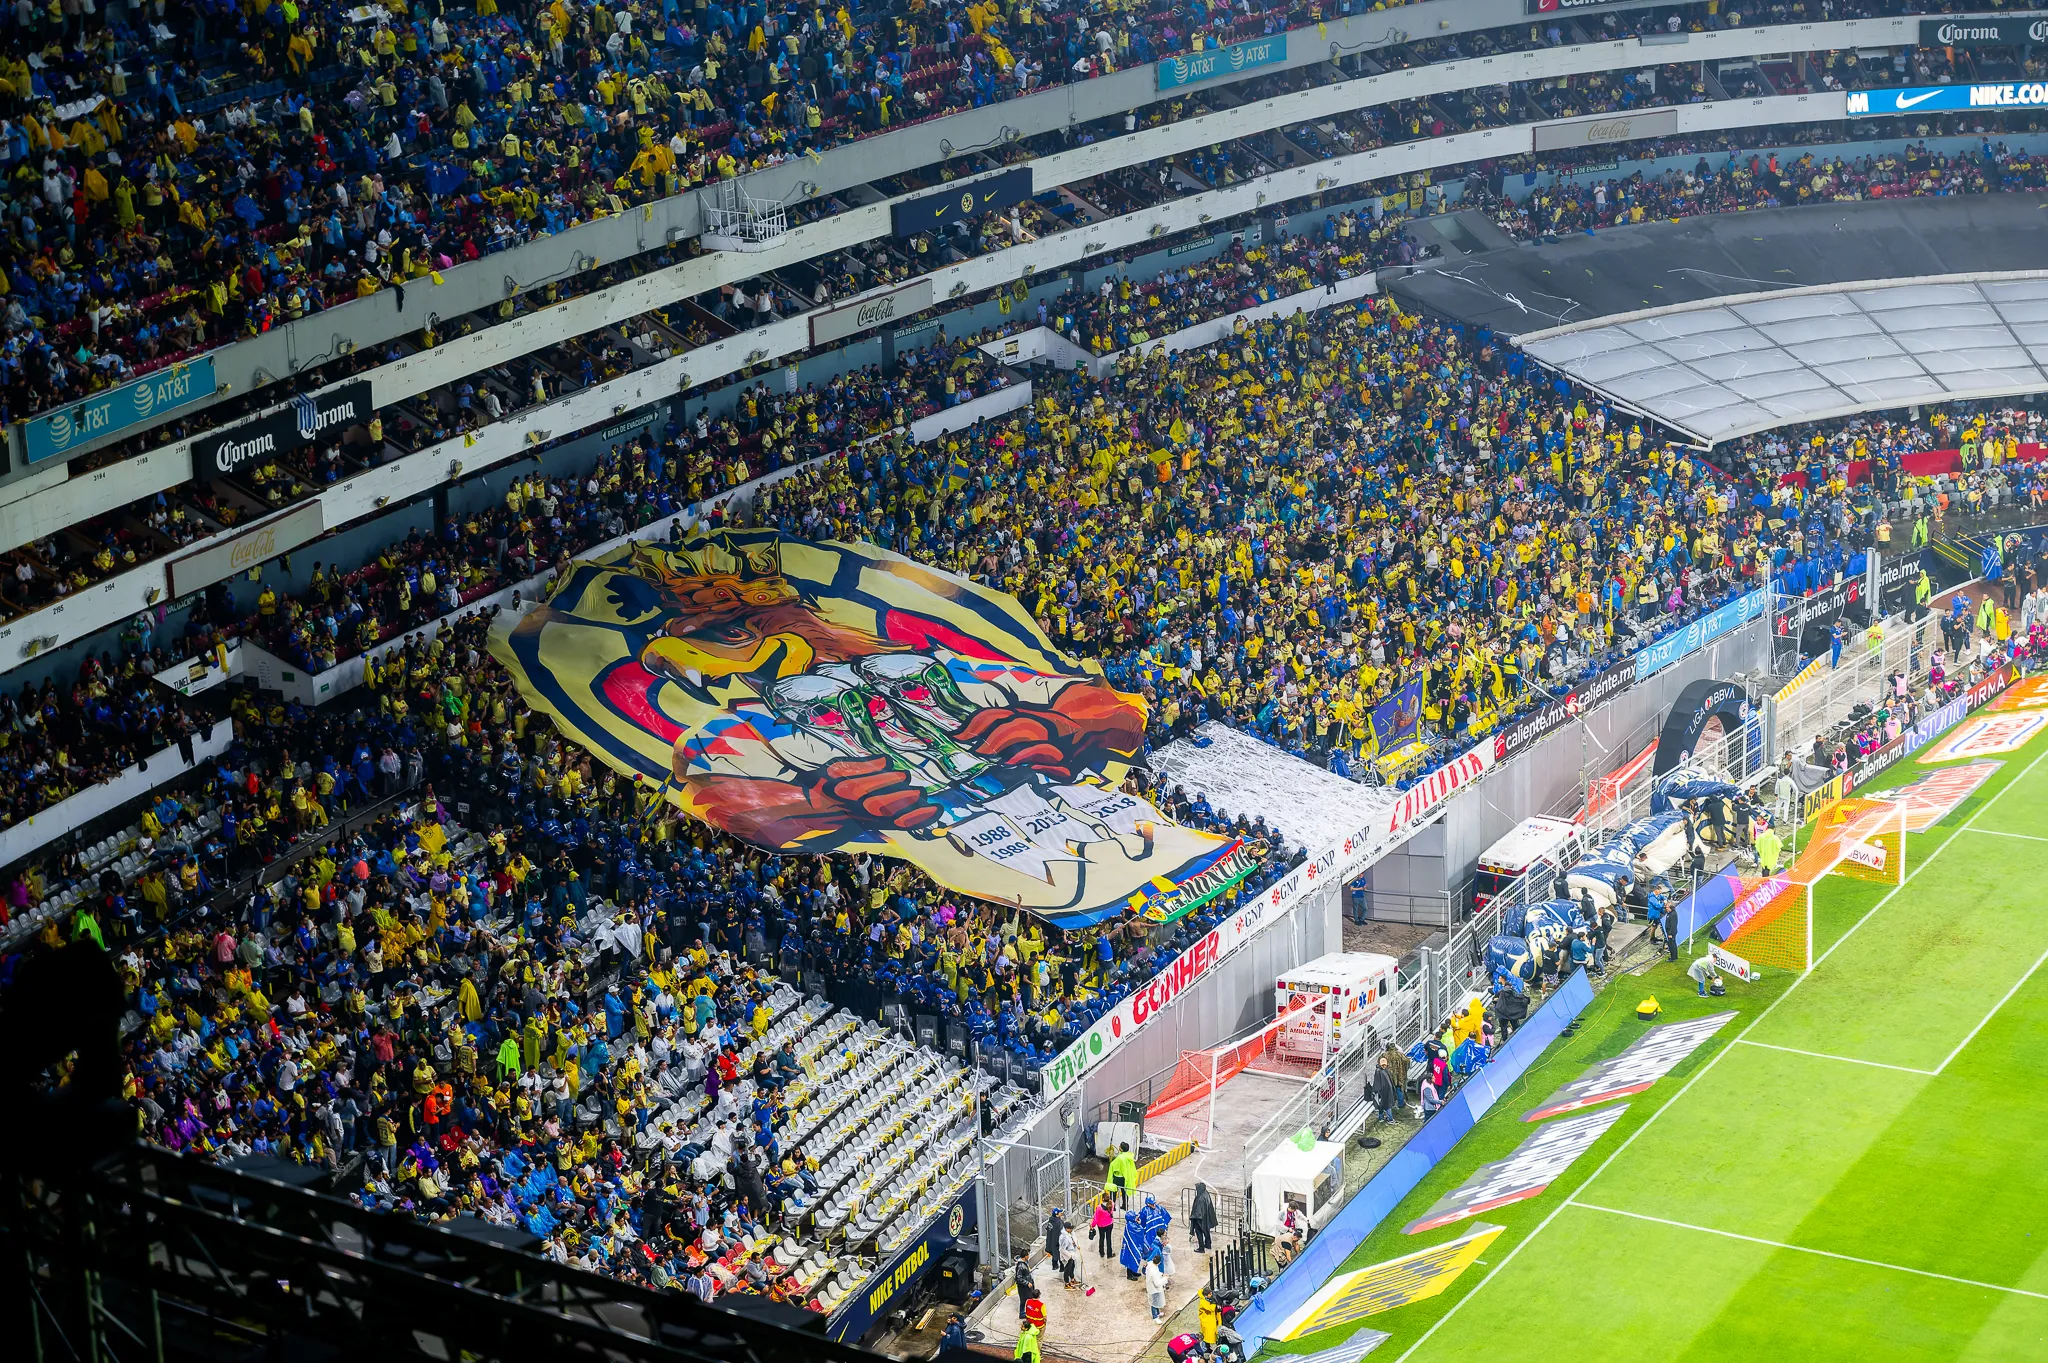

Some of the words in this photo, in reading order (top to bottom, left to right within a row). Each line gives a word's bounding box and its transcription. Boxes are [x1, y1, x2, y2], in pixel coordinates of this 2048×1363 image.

[1937, 22, 1999, 45] Corona
[1245, 44, 1271, 63] AT&T
[1190, 57, 1215, 76] AT&T
[156, 373, 191, 405] AT&T
[607, 427, 620, 438] RUTA
[216, 433, 275, 473] Corona
[1701, 613, 1725, 636] AT&T
[1651, 642, 1674, 665] AT&T
[1578, 665, 1636, 712] caliente.mx
[1966, 674, 2006, 712] PIRMA
[1689, 707, 1706, 735] LIGA
[1713, 685, 1736, 706] BBVA
[1505, 705, 1565, 750] caliente.mx
[1853, 743, 1904, 788] caliente.mx
[1090, 797, 1137, 818] 2018
[970, 825, 1012, 847] 1988
[1351, 825, 1370, 849] GNP
[990, 838, 1031, 860] 1989
[1316, 849, 1335, 874] GNP
[1280, 875, 1299, 900] GNP
[1244, 902, 1264, 928] GNP
[1727, 910, 1750, 931] LIGA
[1756, 878, 1780, 905] BBVA
[1133, 931, 1220, 1025] GONHER
[869, 1278, 894, 1315] NIKE
[892, 1241, 930, 1295] FUTBOL
